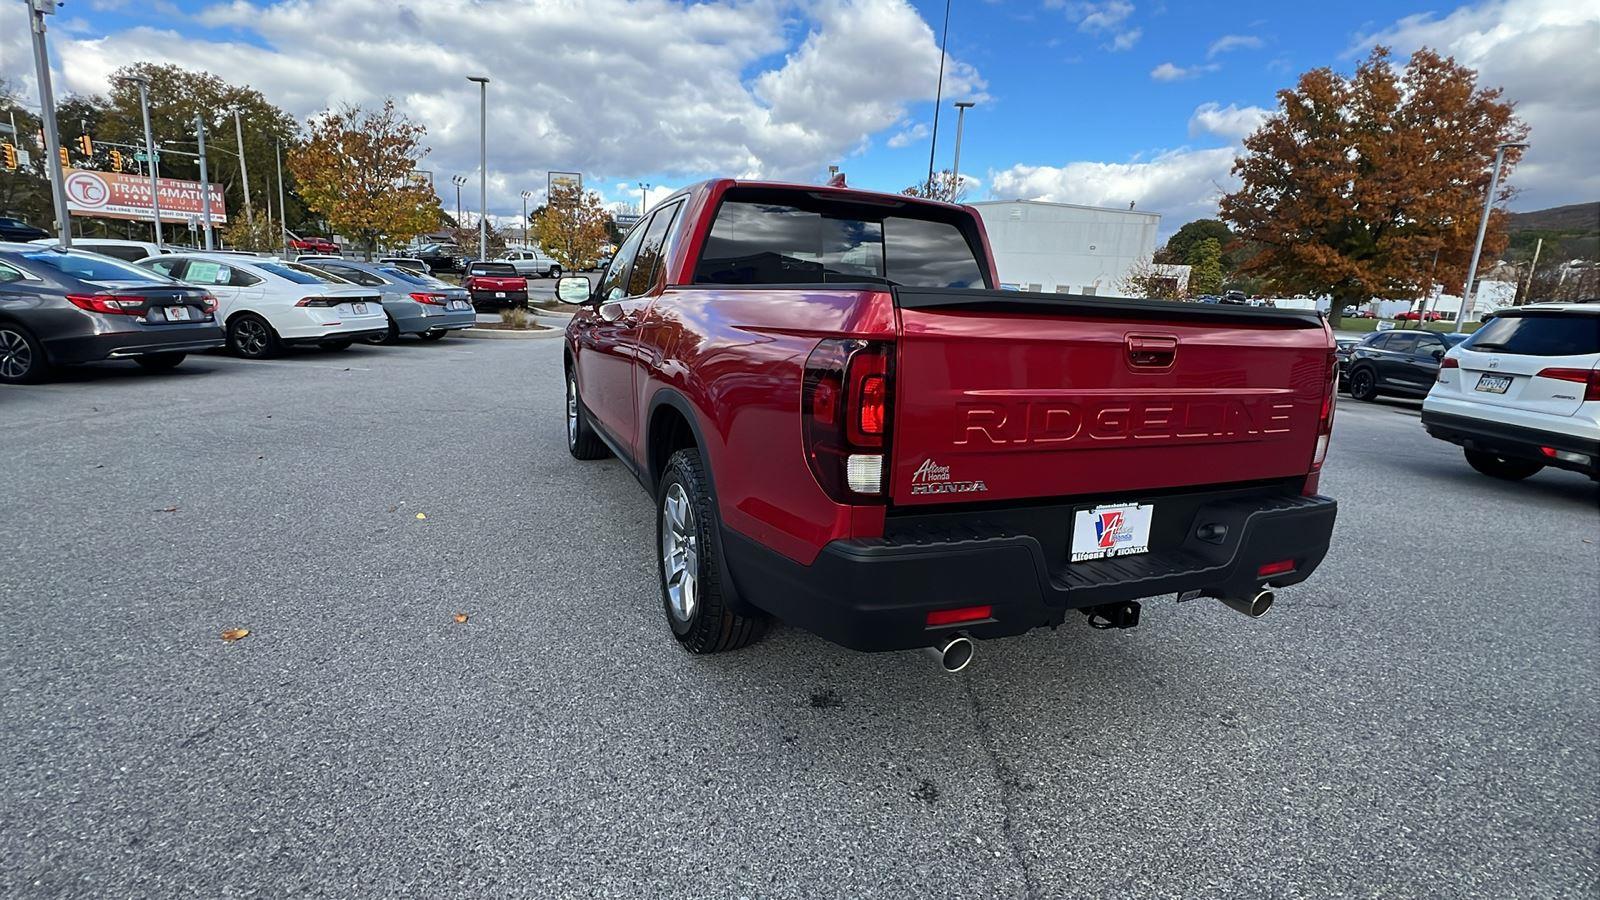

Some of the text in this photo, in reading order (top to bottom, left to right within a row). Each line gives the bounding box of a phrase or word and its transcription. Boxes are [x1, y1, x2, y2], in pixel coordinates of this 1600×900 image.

[953, 400, 1293, 444] RIDGELINE
[927, 473, 950, 481] Honda
[911, 480, 989, 495] HONDA
[1071, 551, 1105, 562] Altoona
[1117, 546, 1149, 556] HONDA
